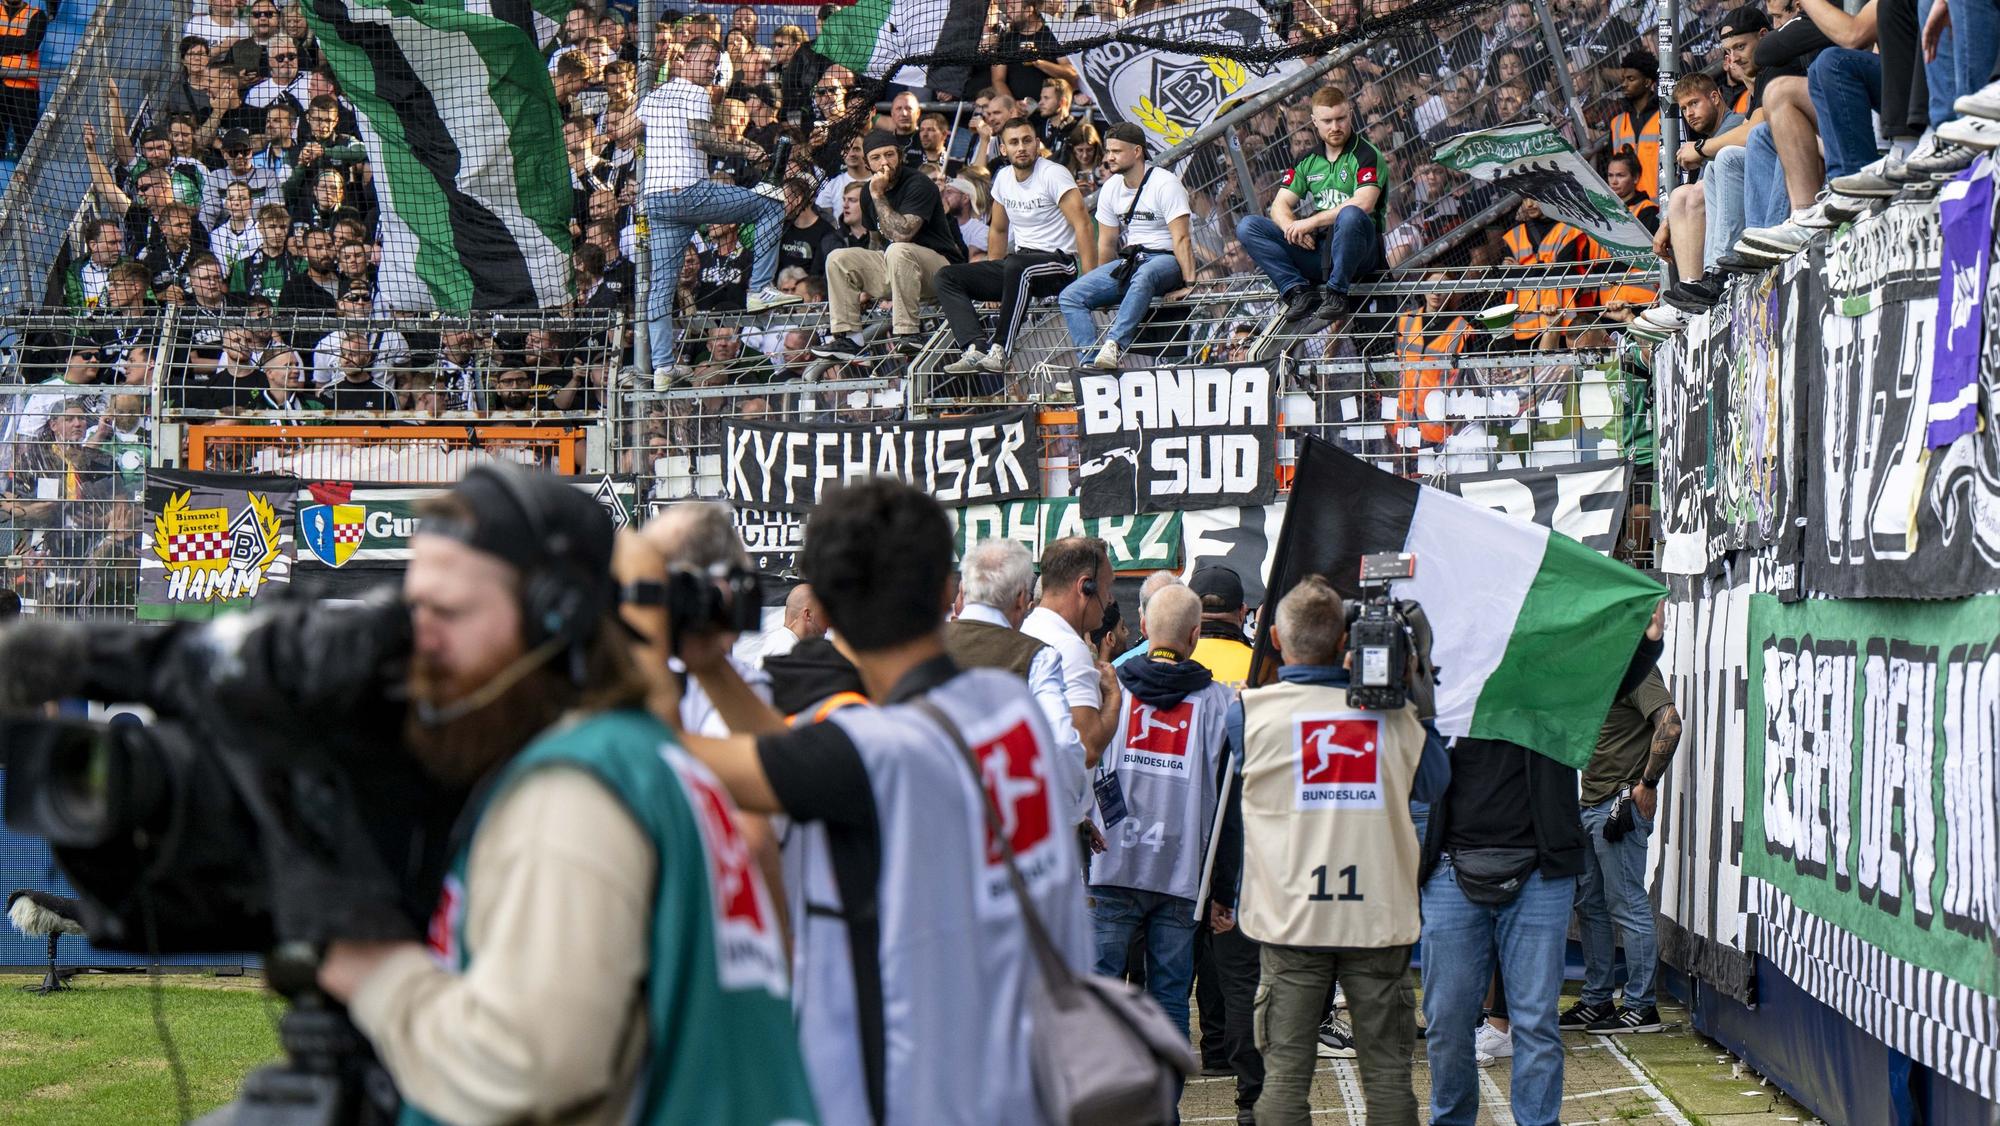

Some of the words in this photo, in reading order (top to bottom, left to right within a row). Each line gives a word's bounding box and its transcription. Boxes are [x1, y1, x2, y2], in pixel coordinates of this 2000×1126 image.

[1079, 367, 1270, 435] BANDA
[727, 420, 1029, 504] KYFFHÄUSER
[1150, 434, 1260, 496] SUD
[175, 511, 220, 522] Bimmel
[168, 566, 263, 602] HAMM
[1123, 754, 1184, 771] BUNDESLIGA
[1302, 790, 1377, 801] BUNDESLIGA
[1857, 637, 1939, 931] DEN
[1120, 816, 1165, 853] 34
[1308, 865, 1364, 901] 11
